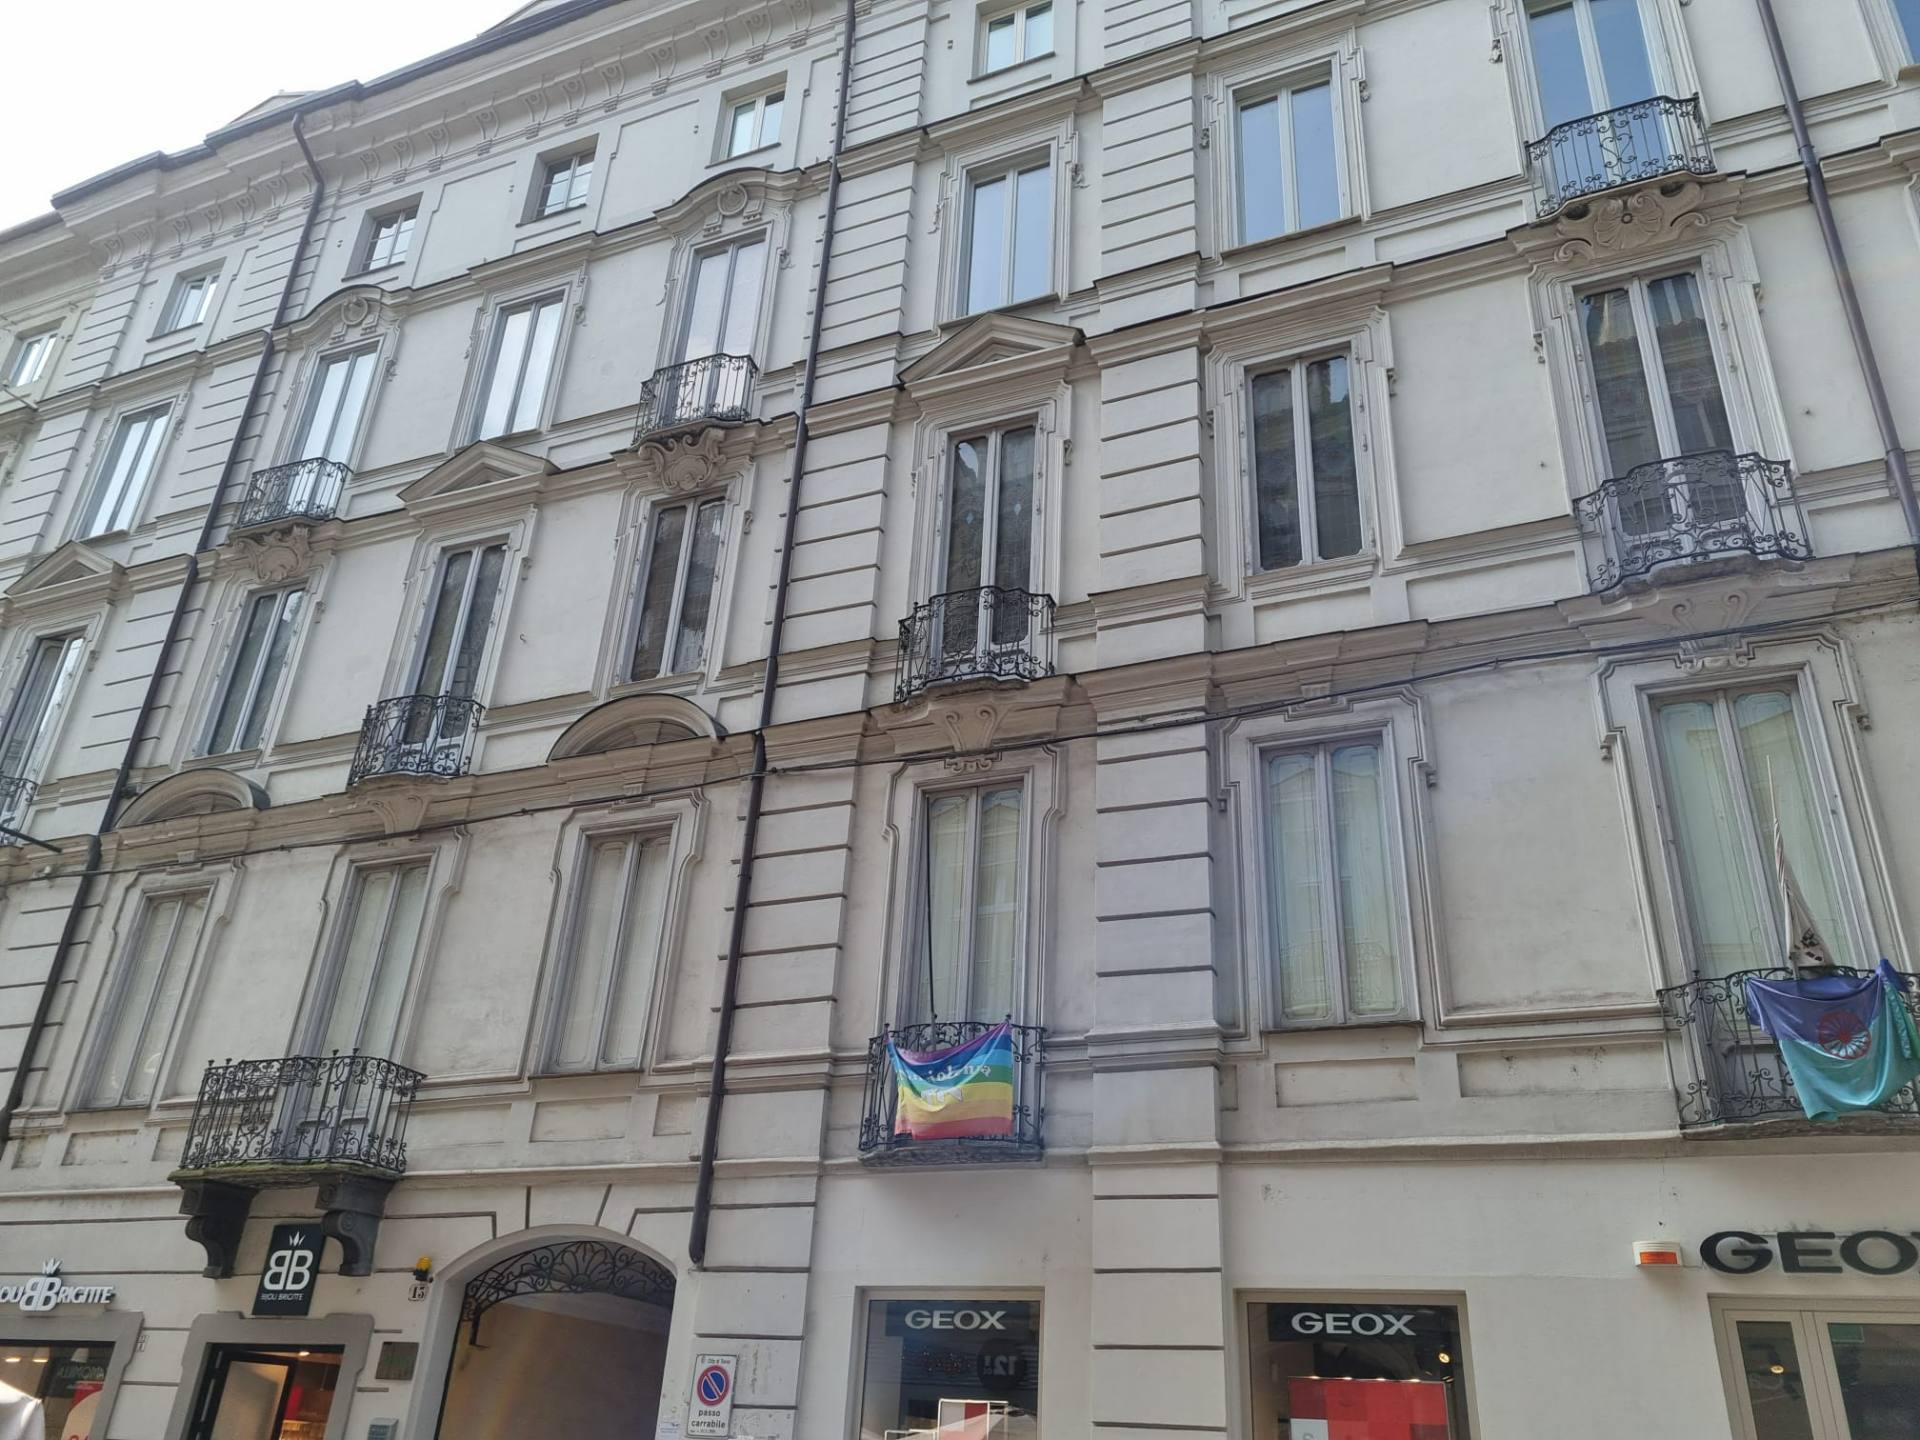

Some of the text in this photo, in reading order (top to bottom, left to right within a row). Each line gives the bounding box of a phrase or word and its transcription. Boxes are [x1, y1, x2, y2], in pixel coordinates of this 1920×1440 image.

[1700, 1230, 1920, 1275] GEO
[905, 1310, 1007, 1330] GEOX
[1291, 1312, 1416, 1336] GEOX
[698, 1409, 720, 1417] passo
[691, 1420, 726, 1429] carrabile
